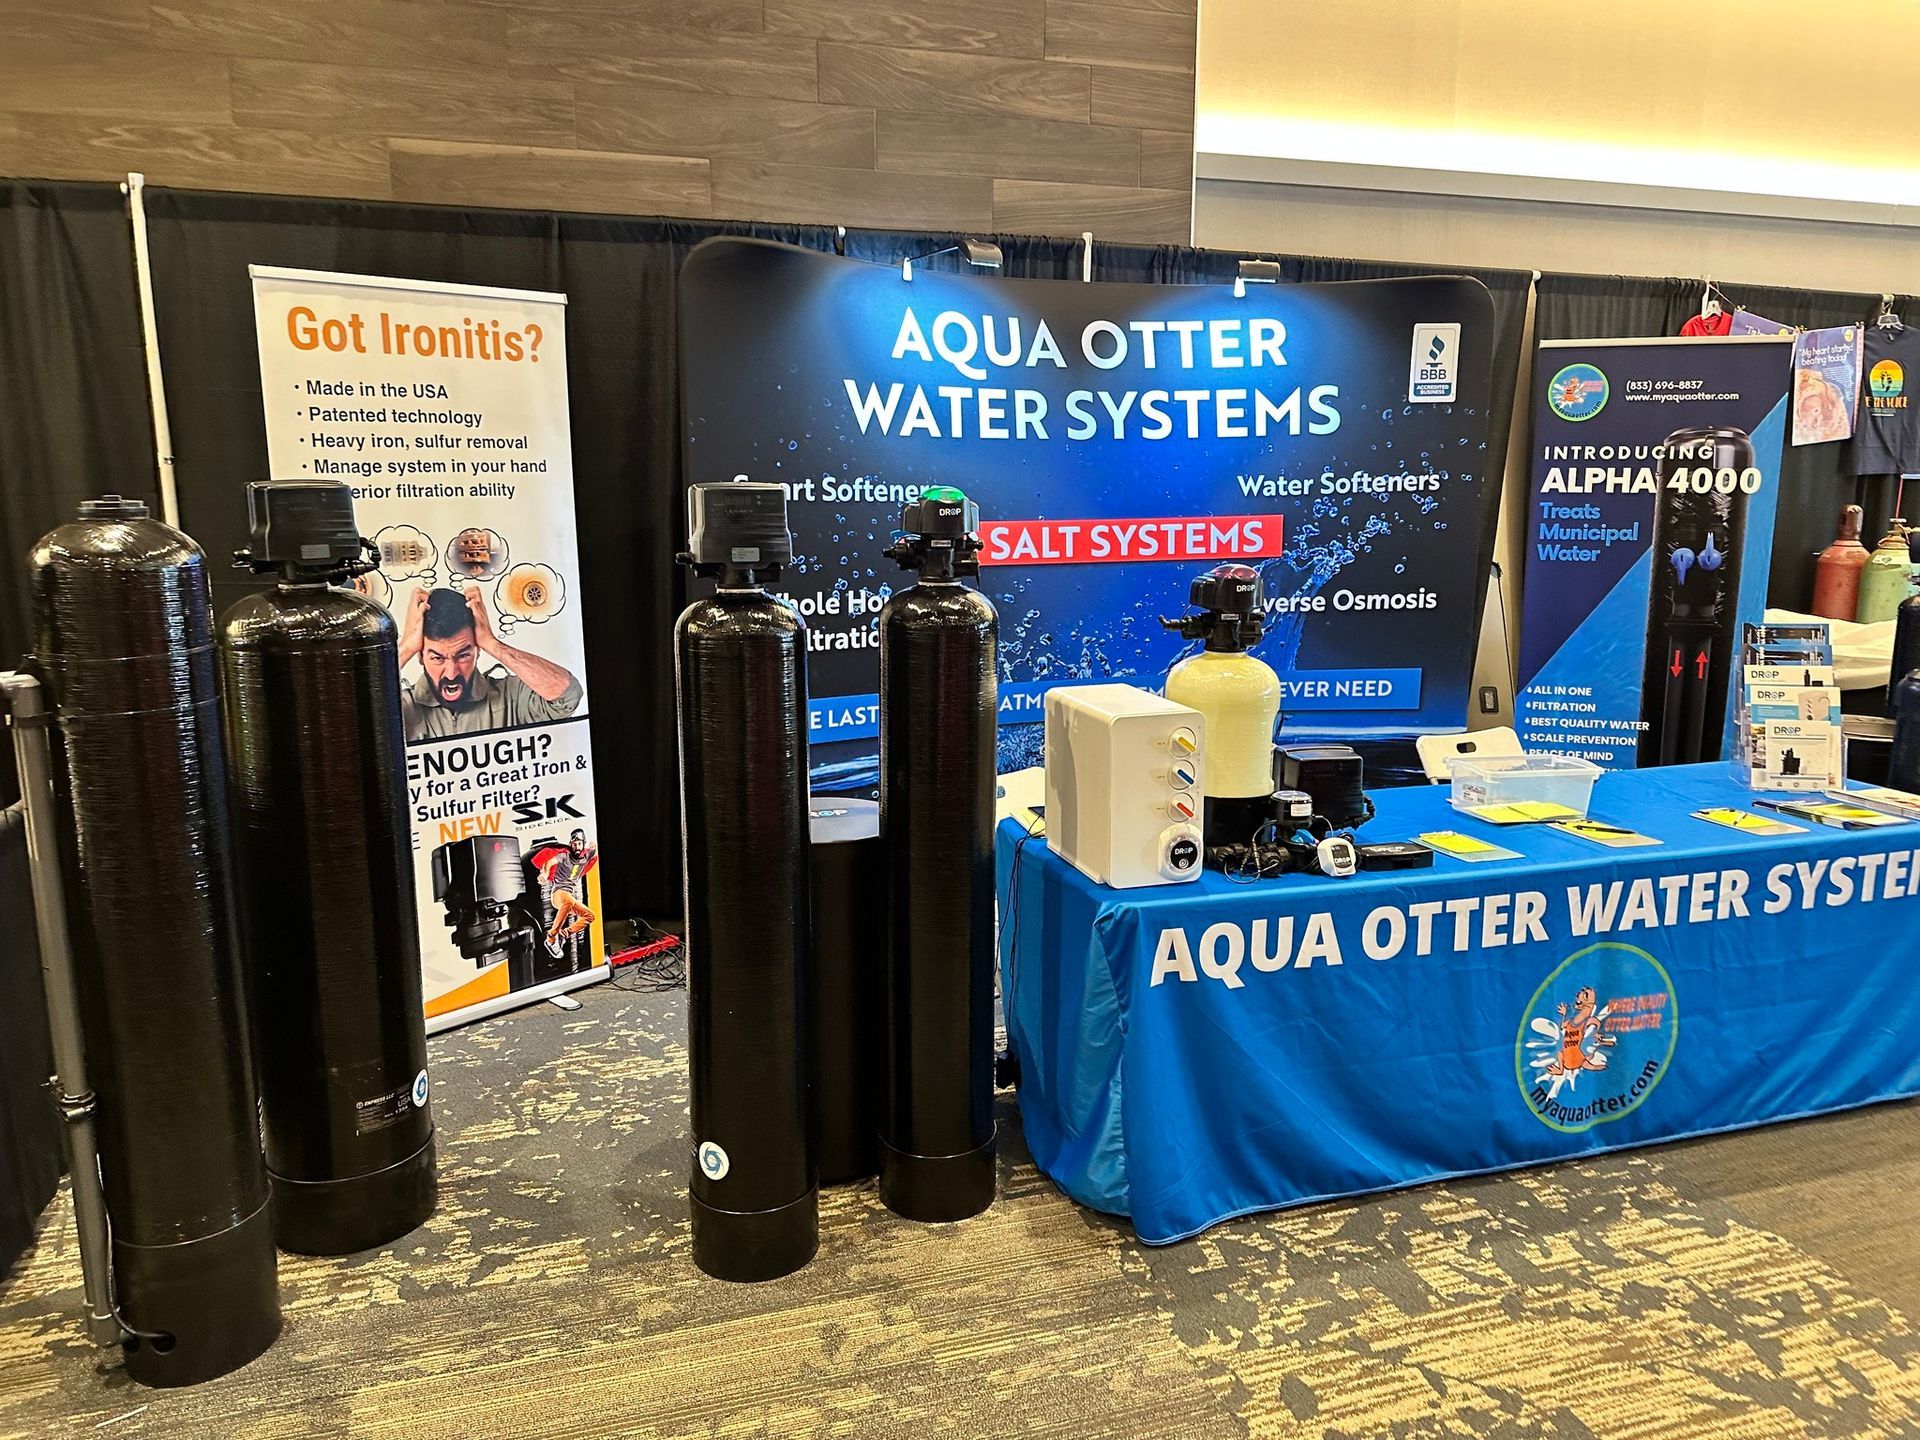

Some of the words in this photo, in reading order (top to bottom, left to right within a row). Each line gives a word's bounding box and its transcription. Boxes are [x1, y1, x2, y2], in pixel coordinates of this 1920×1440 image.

[287, 306, 367, 353] Got
[380, 312, 543, 363] Ironitis?
[891, 306, 1068, 381] AQUA
[1081, 317, 1288, 370] OTTER
[1420, 368, 1447, 380] BBB
[306, 380, 354, 396] Made
[360, 382, 376, 398] in
[380, 382, 408, 398] the
[412, 384, 449, 399] USA
[1626, 380, 1652, 393] (833)
[1654, 380, 1704, 390] 696-8837
[1625, 392, 1740, 404] www.myaquaotter.com
[309, 406, 386, 423] Patented
[391, 409, 482, 428] technology
[843, 379, 1050, 440] WATER
[1065, 385, 1342, 440] SYSTEMS
[312, 433, 365, 452] Heavy
[372, 434, 410, 450] iron,
[415, 434, 462, 449] sulfur
[467, 436, 528, 450] removal
[1544, 445, 1714, 460] INTRODUCING
[314, 459, 382, 476] Manage
[388, 460, 446, 476] system
[452, 460, 466, 474] in
[471, 462, 506, 477] your
[510, 459, 547, 472] hand
[1237, 474, 1314, 497] Water
[1320, 470, 1440, 495] Softeners
[1540, 467, 1658, 494] ALPHA
[1666, 466, 1762, 494] 4000
[396, 484, 464, 498] filtration
[470, 484, 515, 500] ability
[822, 477, 937, 502] Softener
[1539, 502, 1600, 520] Treats
[990, 526, 1081, 560] SALT
[1090, 521, 1264, 557] SYSTEMS
[1538, 522, 1640, 544] Municipal
[1538, 544, 1600, 562] Water
[1261, 594, 1326, 614] verse
[1332, 588, 1438, 612] Osmosis
[1751, 670, 1779, 678] DROP
[1335, 680, 1394, 698] NEED
[1534, 685, 1552, 695] ALL
[1554, 686, 1566, 696] IN
[1568, 686, 1592, 696] ONE
[1758, 690, 1786, 700] DROP
[1532, 701, 1596, 712] FILTRATION
[1531, 717, 1558, 726] BEST
[1560, 718, 1608, 729] QUALITY
[1610, 720, 1650, 731] WATER
[1774, 726, 1802, 735] DROP
[1530, 732, 1564, 742] SCALE
[1566, 734, 1636, 746] PREVENTION
[407, 734, 552, 780] ENOUGH?
[1583, 752, 1614, 761] MIND
[426, 780, 454, 797] for
[460, 778, 472, 791] a
[476, 764, 528, 788] Great
[533, 760, 570, 778] Iron
[575, 754, 588, 770] &
[416, 800, 476, 822] Sulfur
[482, 784, 540, 810] Filter?
[512, 794, 586, 825] SK
[808, 809, 848, 818] ROP
[438, 812, 502, 844] NEW
[1174, 846, 1194, 855] DROP
[1150, 912, 1343, 990] AQUA
[1360, 890, 1550, 960] OTTER
[1567, 868, 1750, 938] WATER
[1530, 1058, 1660, 1126] myaquaotter.com
